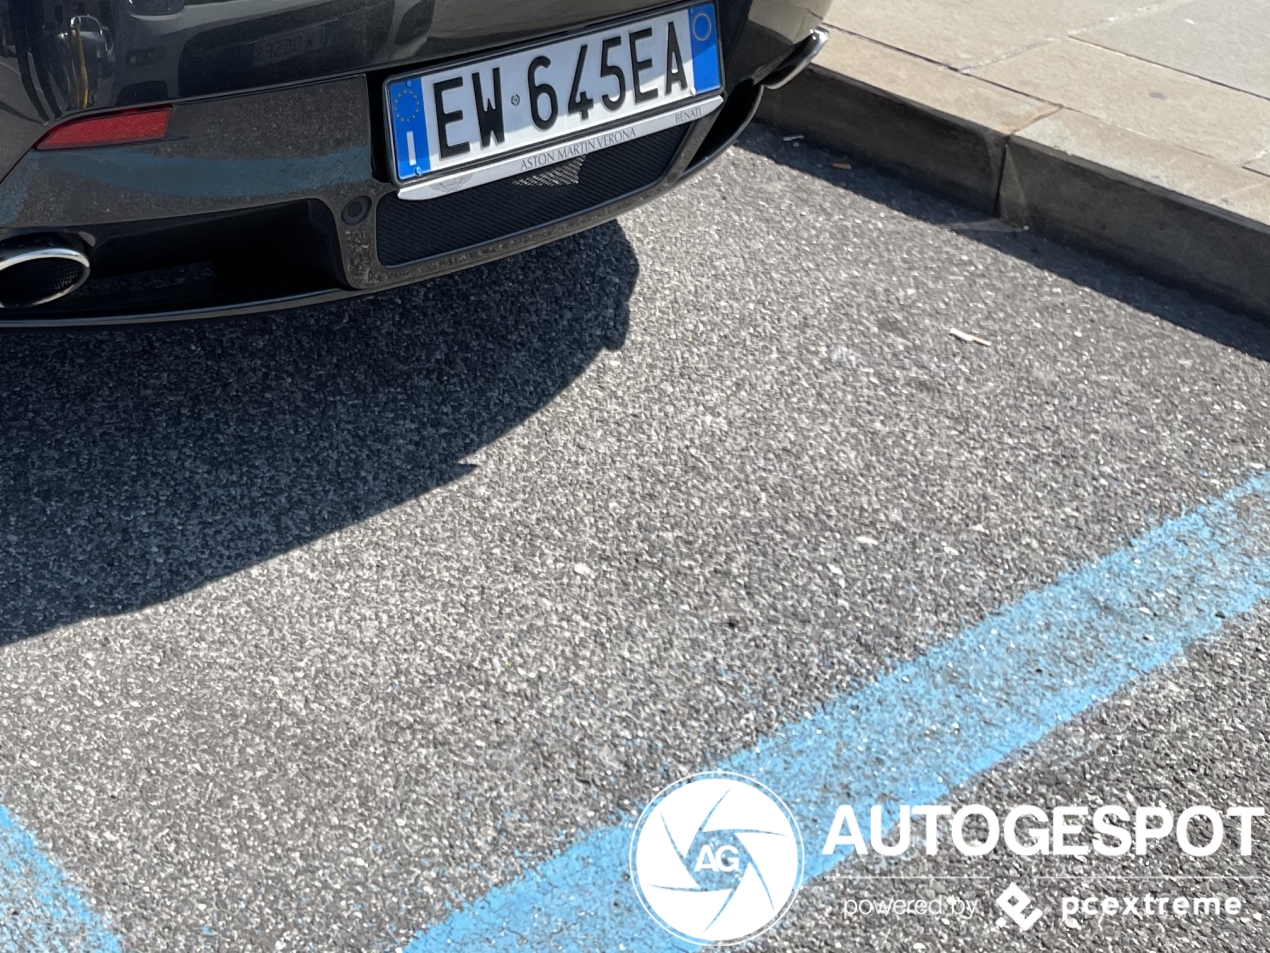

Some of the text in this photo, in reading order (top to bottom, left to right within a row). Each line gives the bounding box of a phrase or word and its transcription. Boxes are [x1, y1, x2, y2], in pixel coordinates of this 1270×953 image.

[433, 20, 688, 159] EW 645EA
[520, 107, 702, 172] ASTON MARTIN VERONA BENATI
